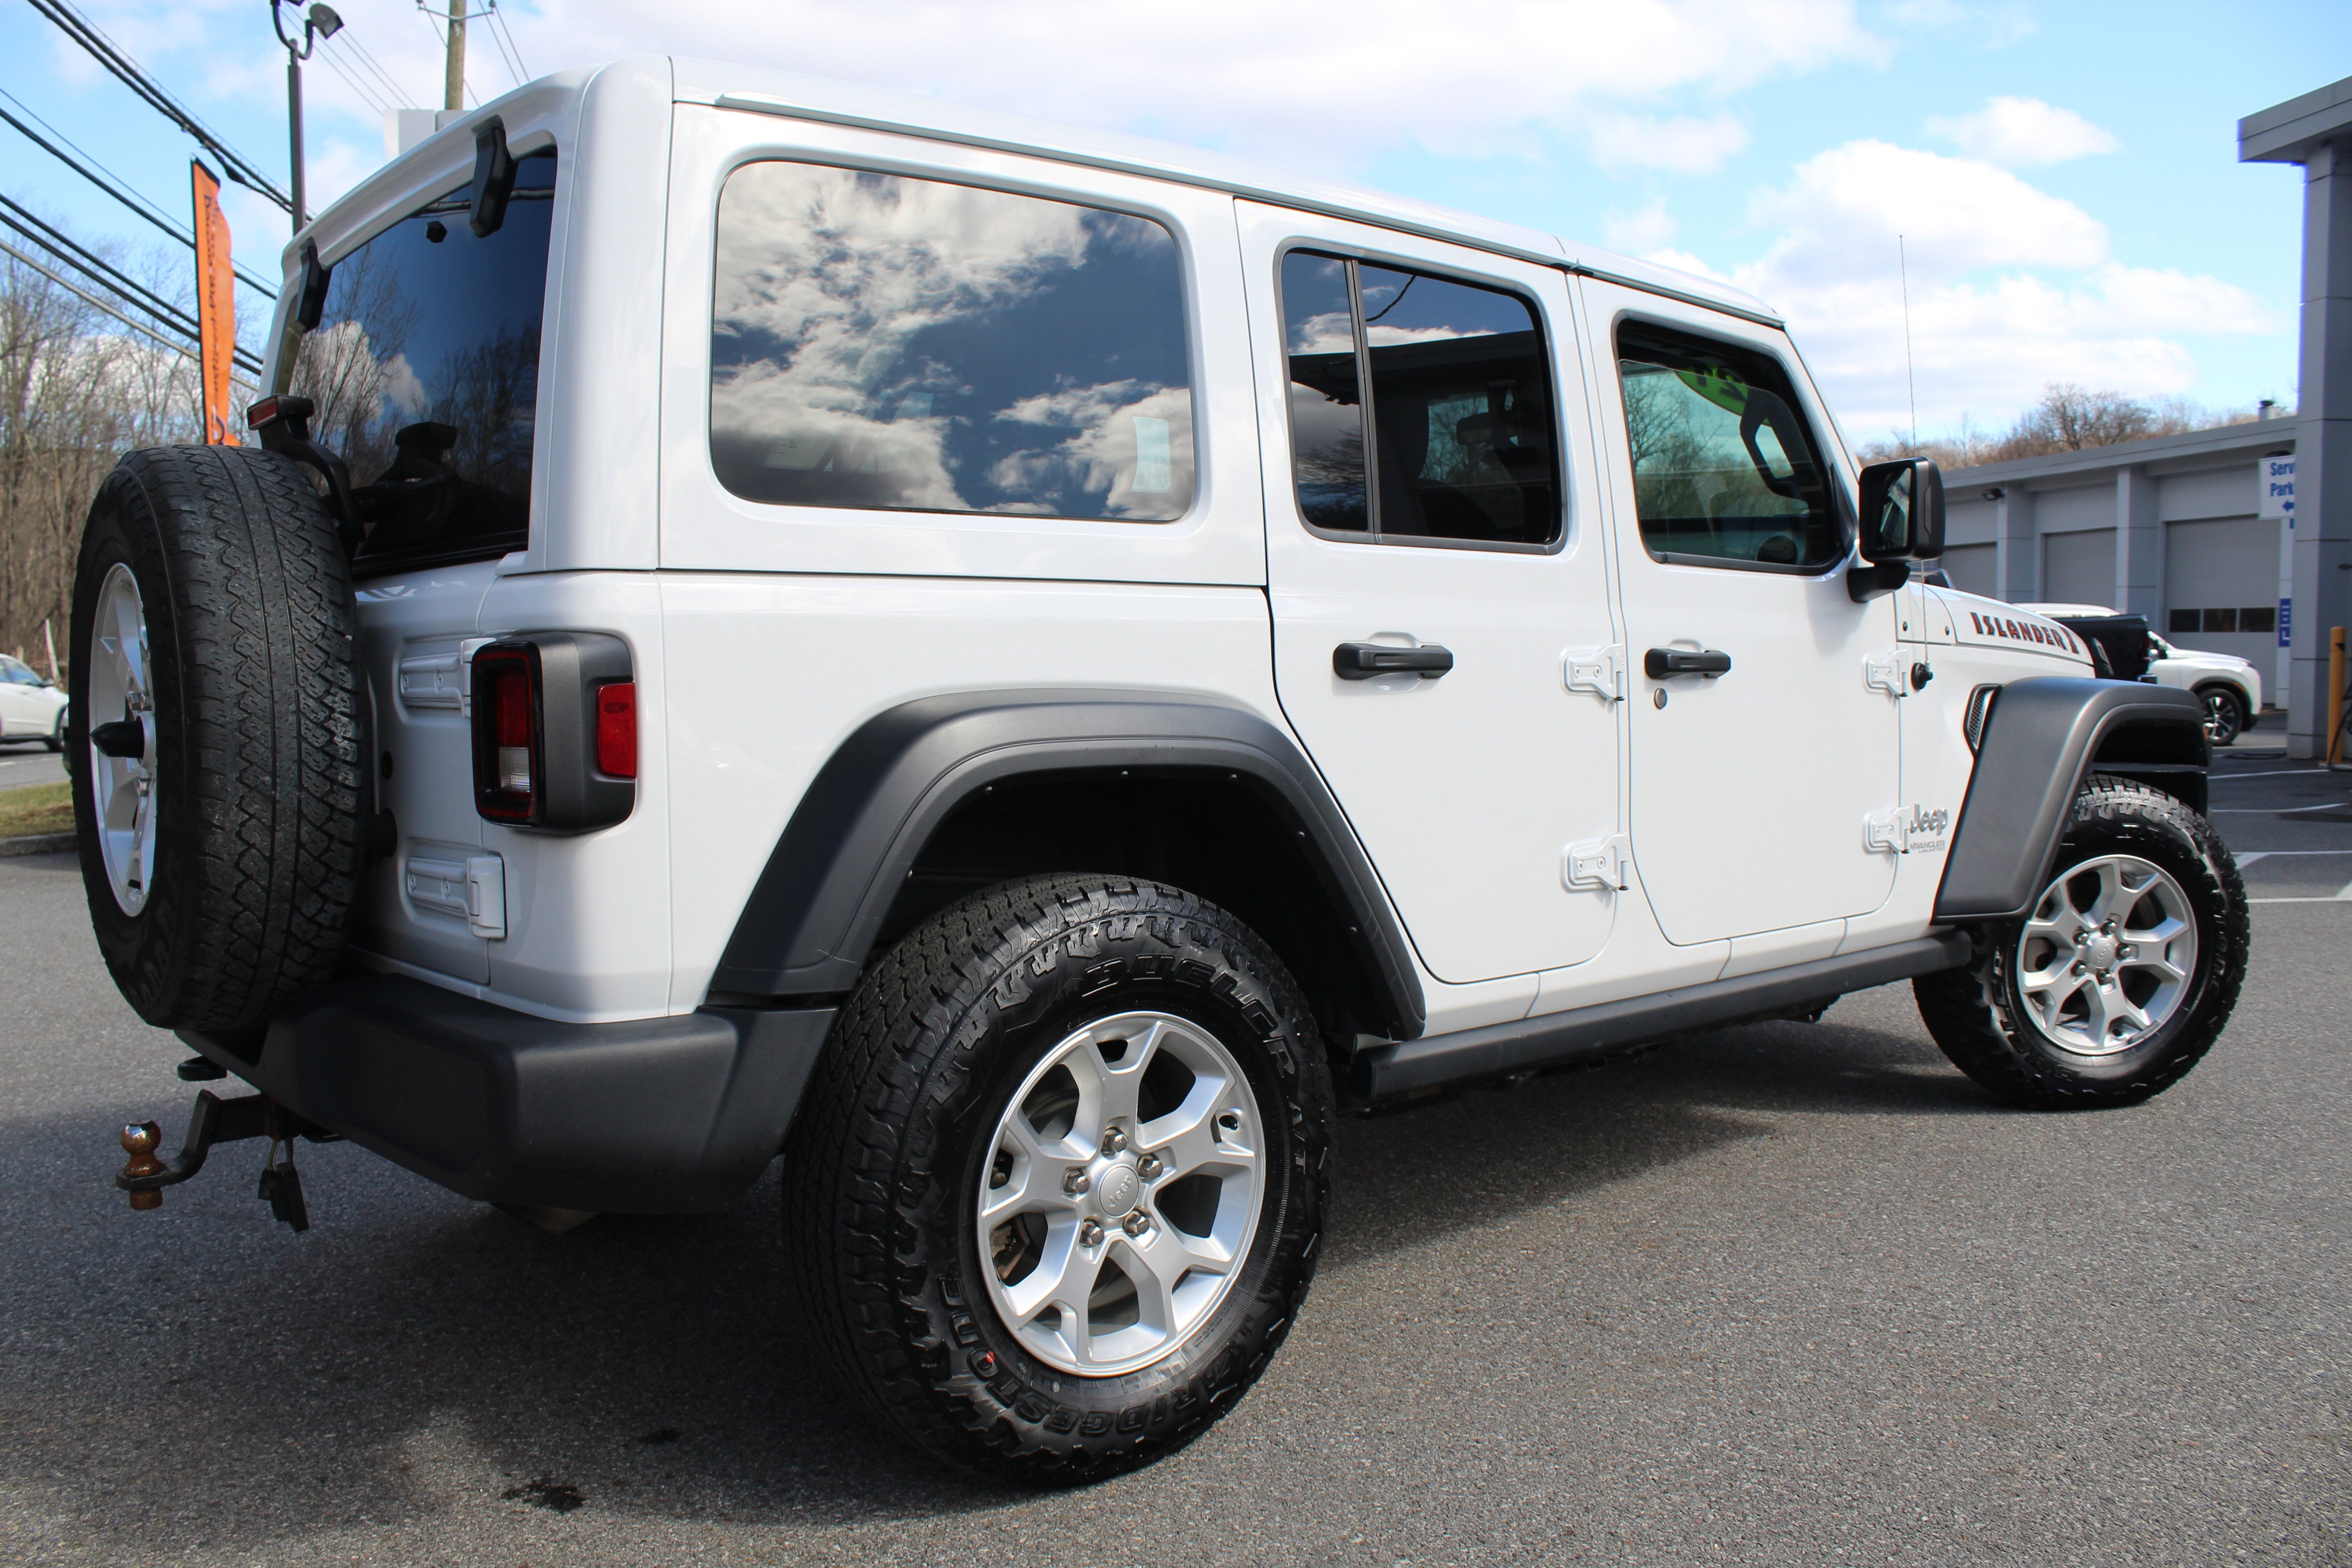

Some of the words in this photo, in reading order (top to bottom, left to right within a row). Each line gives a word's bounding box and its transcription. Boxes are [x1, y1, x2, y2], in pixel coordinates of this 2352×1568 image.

[1970, 612, 2068, 650] ISLANDER
[1910, 804, 1948, 835] Jeep
[1909, 840, 1945, 850] WRANGLER
[1082, 953, 1296, 1079] DUELER
[1108, 1175, 1132, 1209] Jeep
[937, 1274, 1231, 1438] BRIDGESTONE
